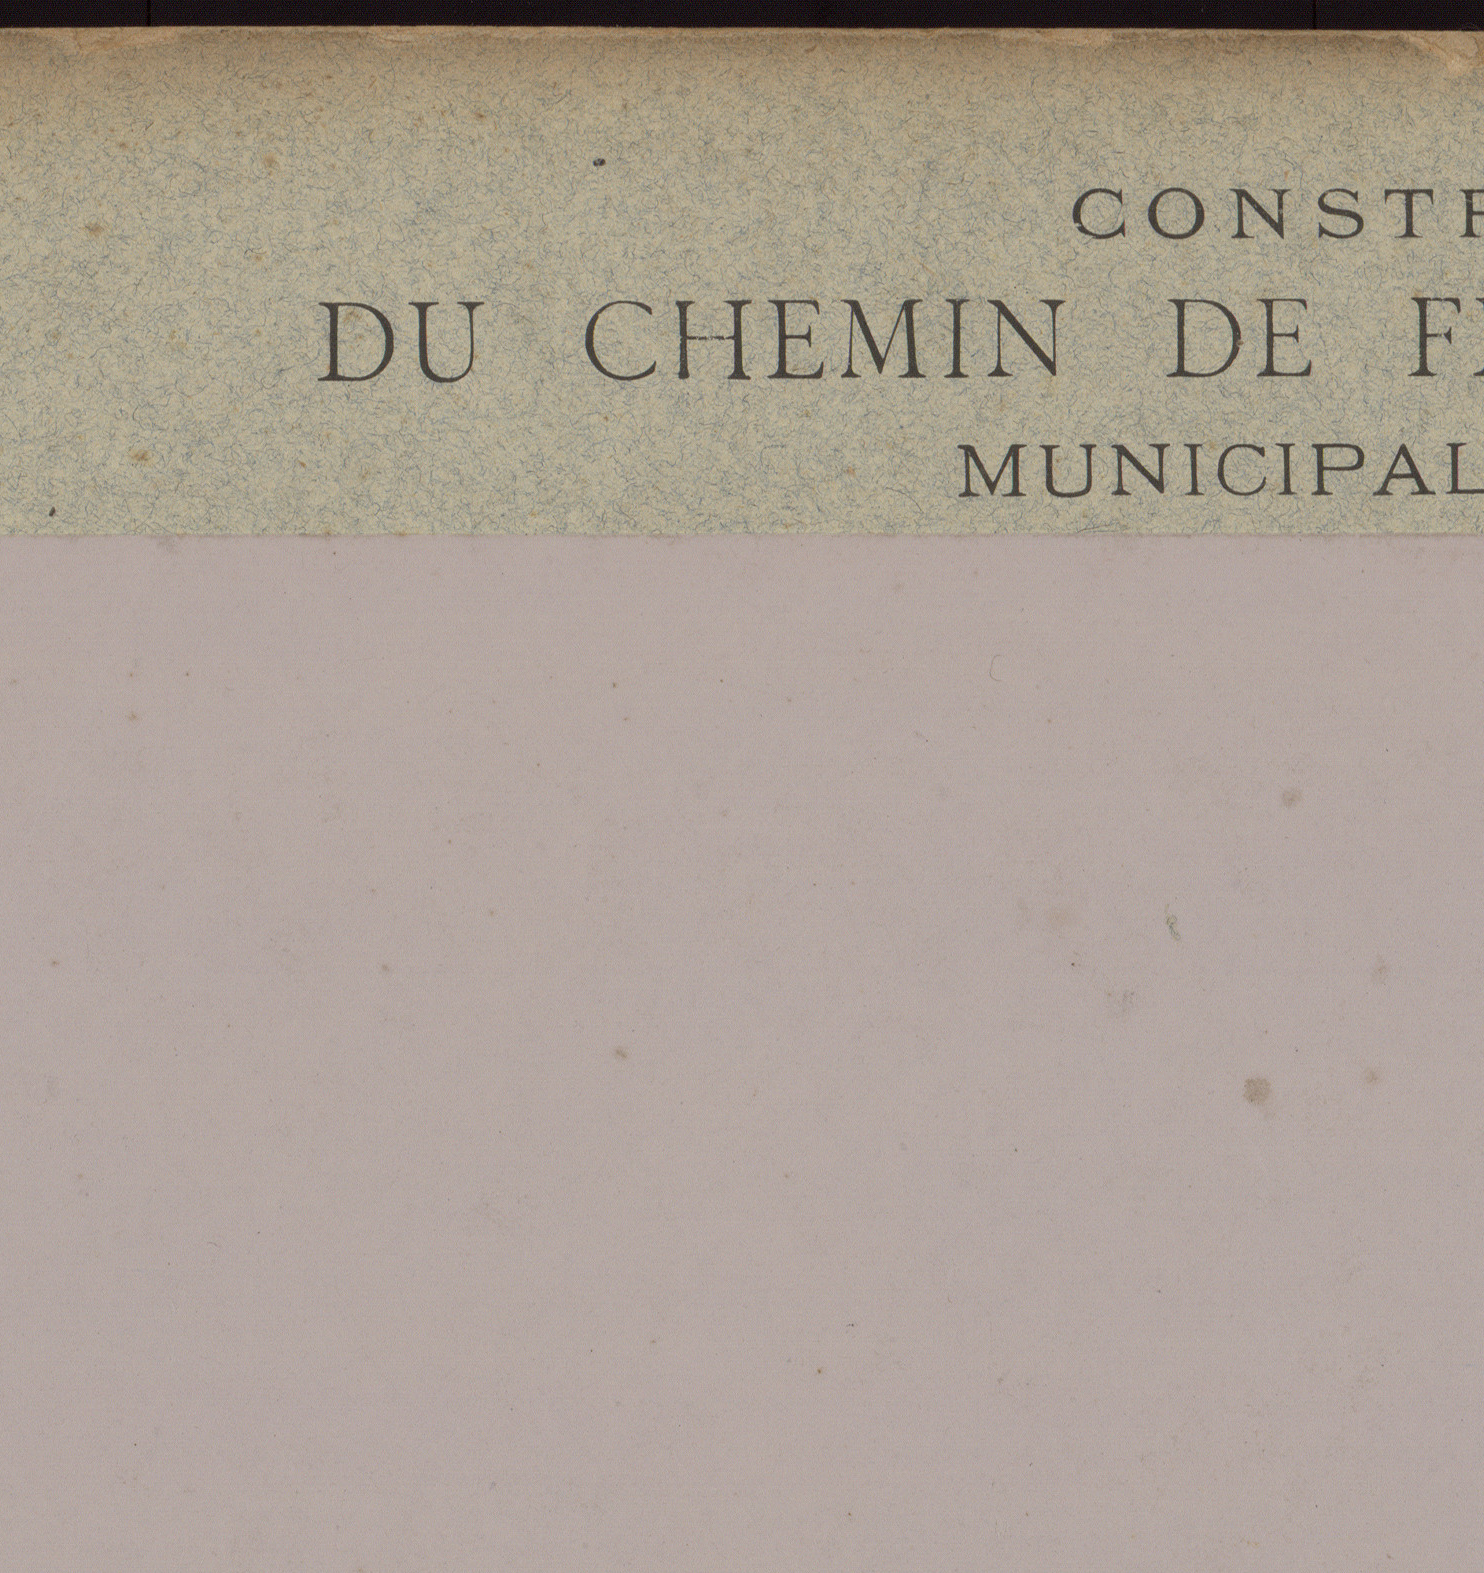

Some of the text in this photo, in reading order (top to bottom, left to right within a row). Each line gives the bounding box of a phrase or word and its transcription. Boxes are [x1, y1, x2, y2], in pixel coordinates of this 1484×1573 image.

[318, 300, 483, 384] DU
[584, 297, 1065, 382] CHEMIN
[1167, 297, 1313, 379] DE
